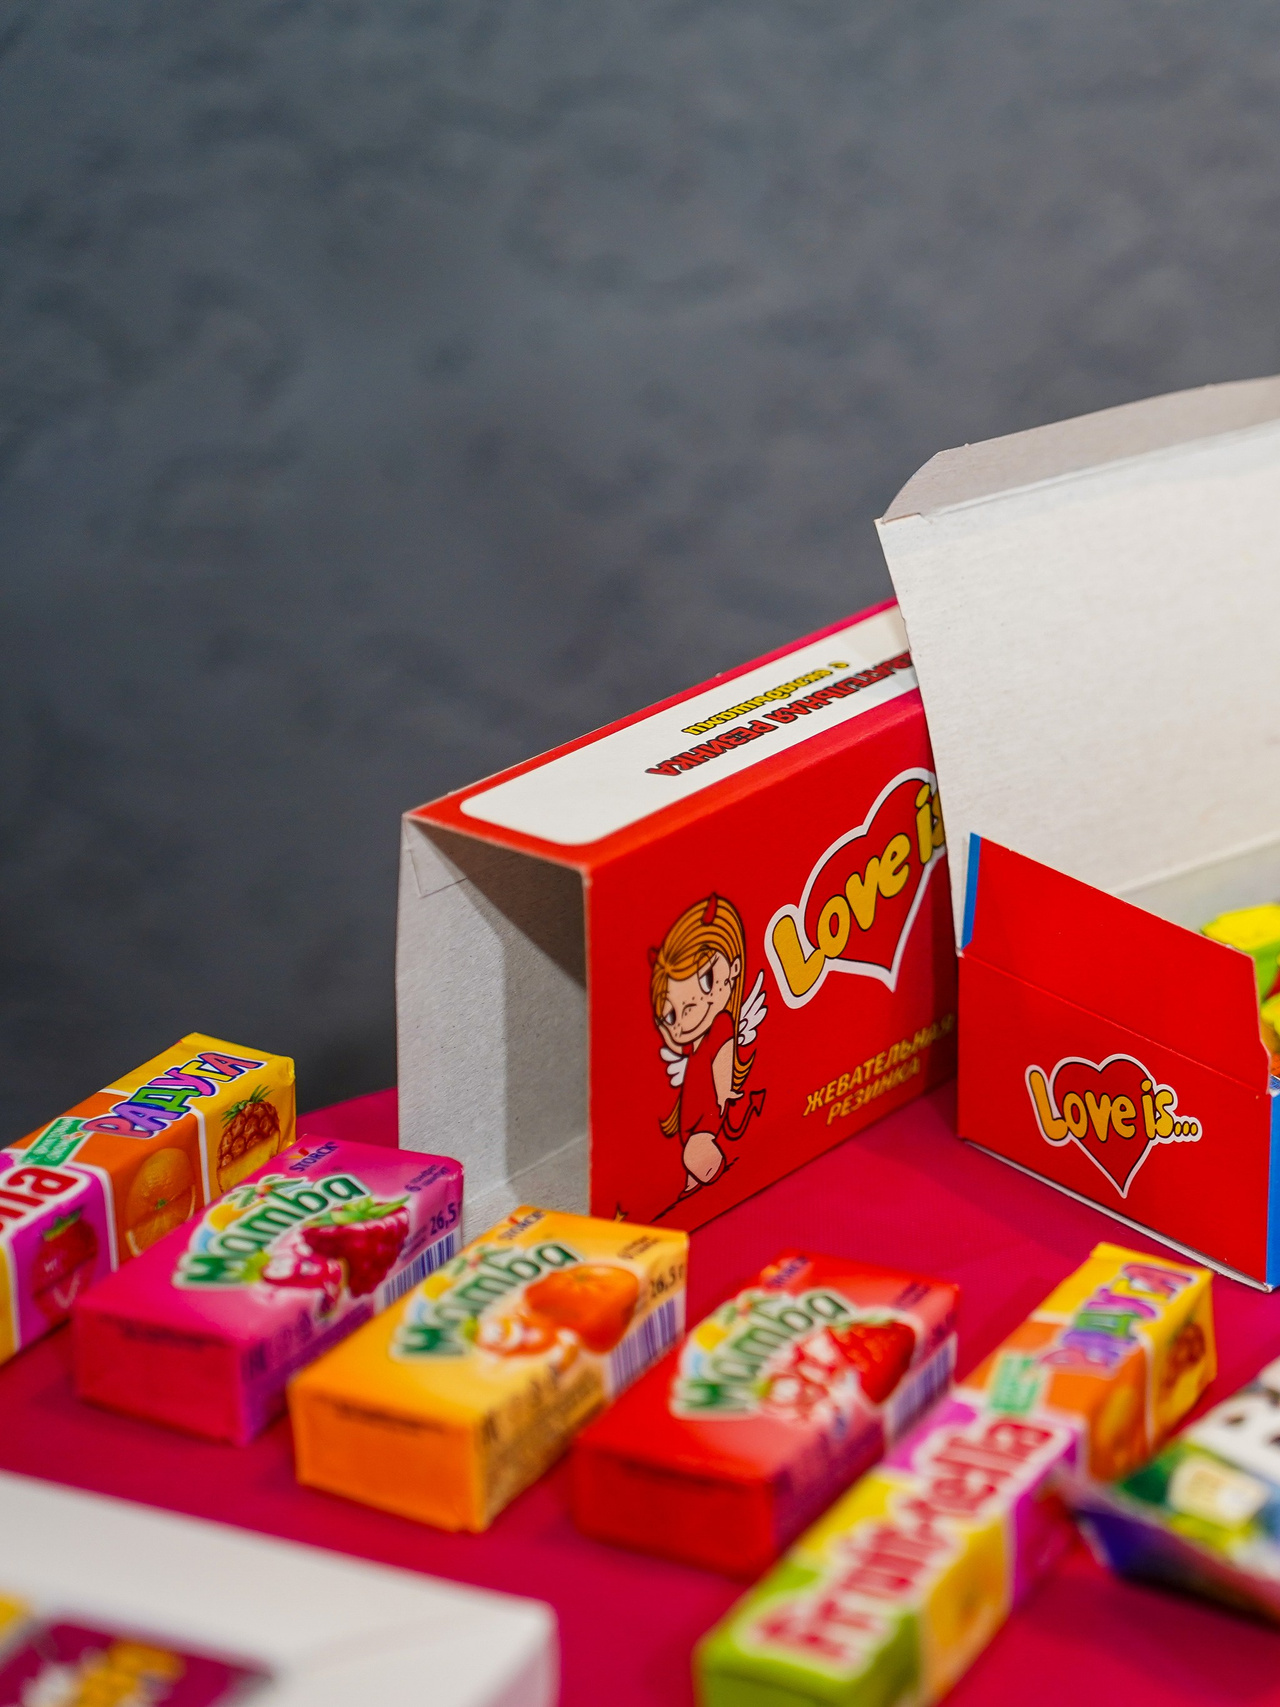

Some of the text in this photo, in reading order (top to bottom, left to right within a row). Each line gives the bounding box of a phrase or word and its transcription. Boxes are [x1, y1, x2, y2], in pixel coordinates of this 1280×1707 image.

[645, 650, 913, 776] ВАТЕЛЬНАЯ РЕЗИНКА
[772, 832, 912, 998] Love
[80, 1052, 266, 1138] РАДУГА
[803, 1013, 955, 1118] ЖЕВАТЕЛЬНАЯ
[826, 1057, 921, 1126] РЕЗИНКА
[1028, 1070, 1199, 1143] Love is...
[289, 1141, 339, 1173] STORCK
[184, 1175, 368, 1283] Mamba
[429, 1202, 457, 1237] 26,5
[404, 1243, 580, 1356] Mamba
[684, 1293, 850, 1413] Mamba
